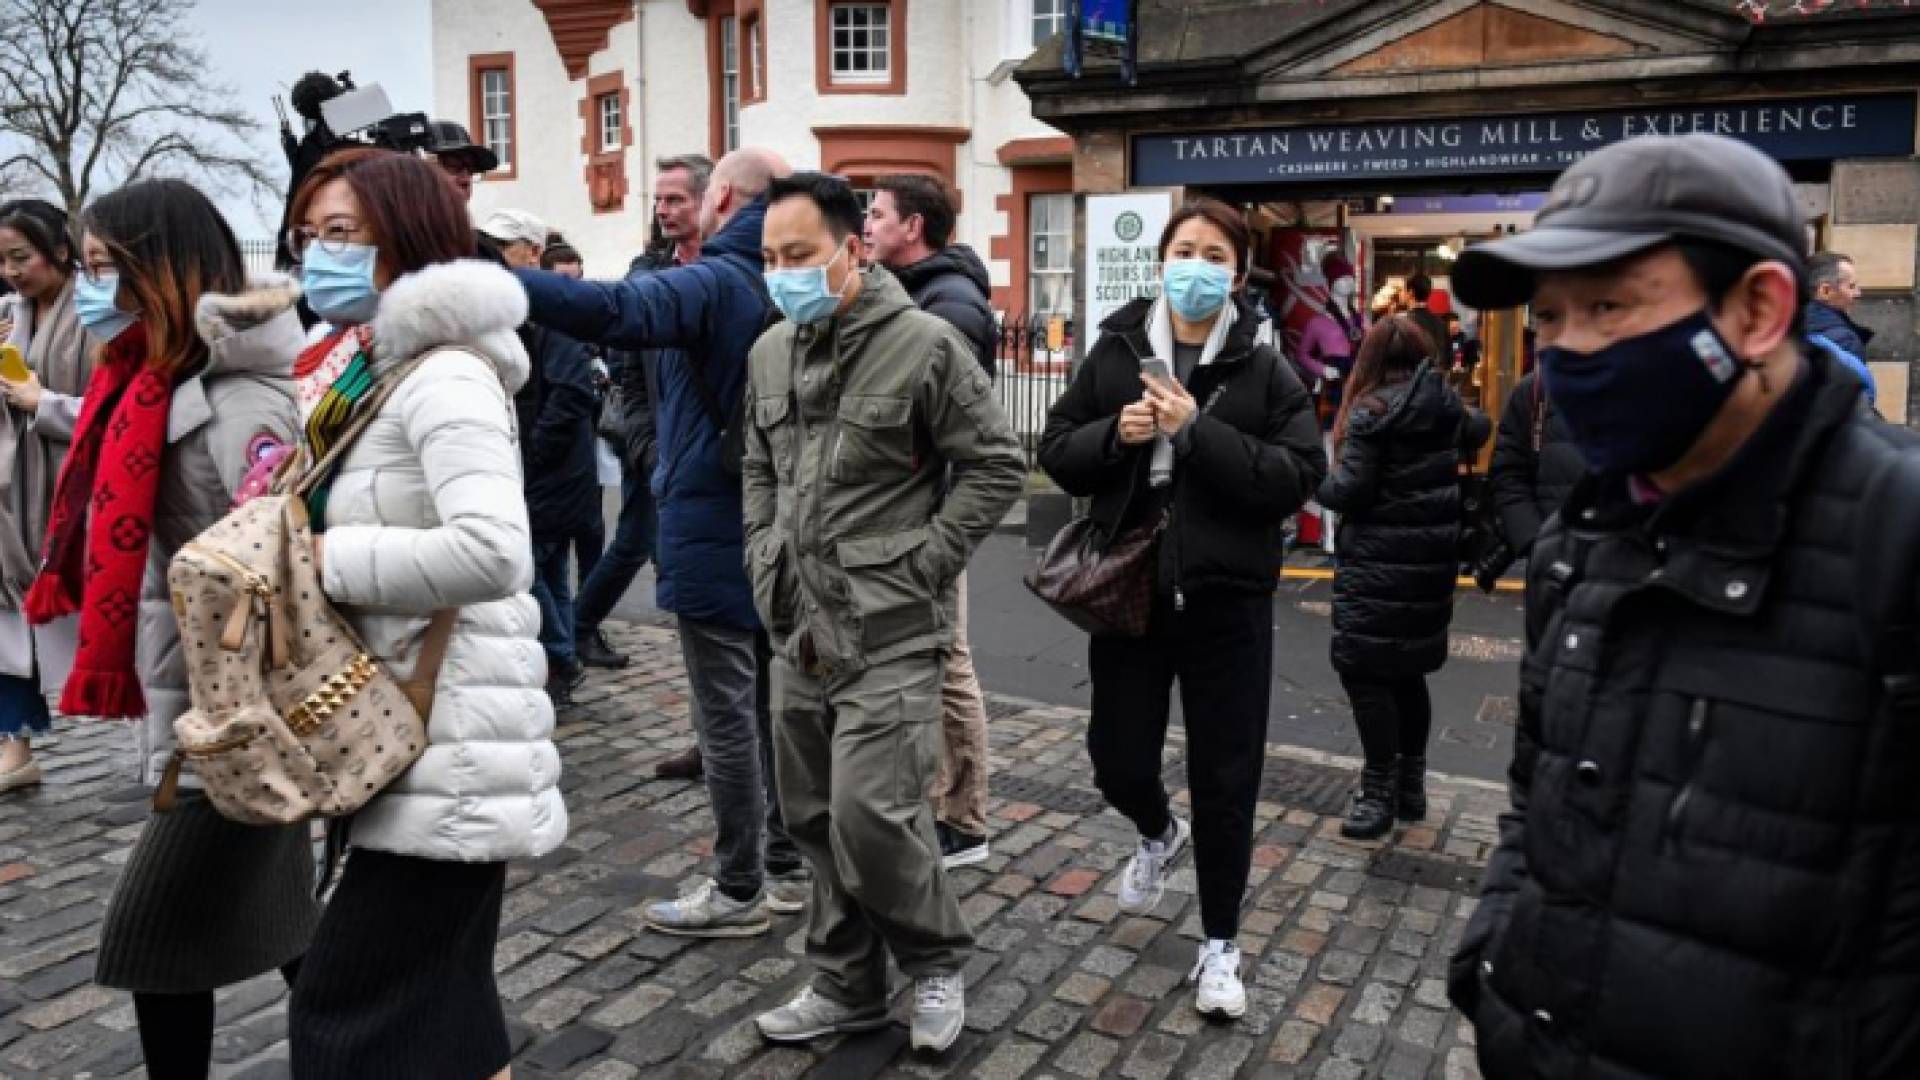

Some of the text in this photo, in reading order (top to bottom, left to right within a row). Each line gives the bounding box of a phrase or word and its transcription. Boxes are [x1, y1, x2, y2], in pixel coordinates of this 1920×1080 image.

[1172, 104, 1857, 160] TARTAN WEAVING MILL & EXPERIENCE
[1277, 161, 1348, 175] CASHMERE
[1363, 158, 1408, 171] TWEED
[1425, 153, 1538, 168] HIGHLANDWEAR
[1098, 265, 1139, 281] TOURS
